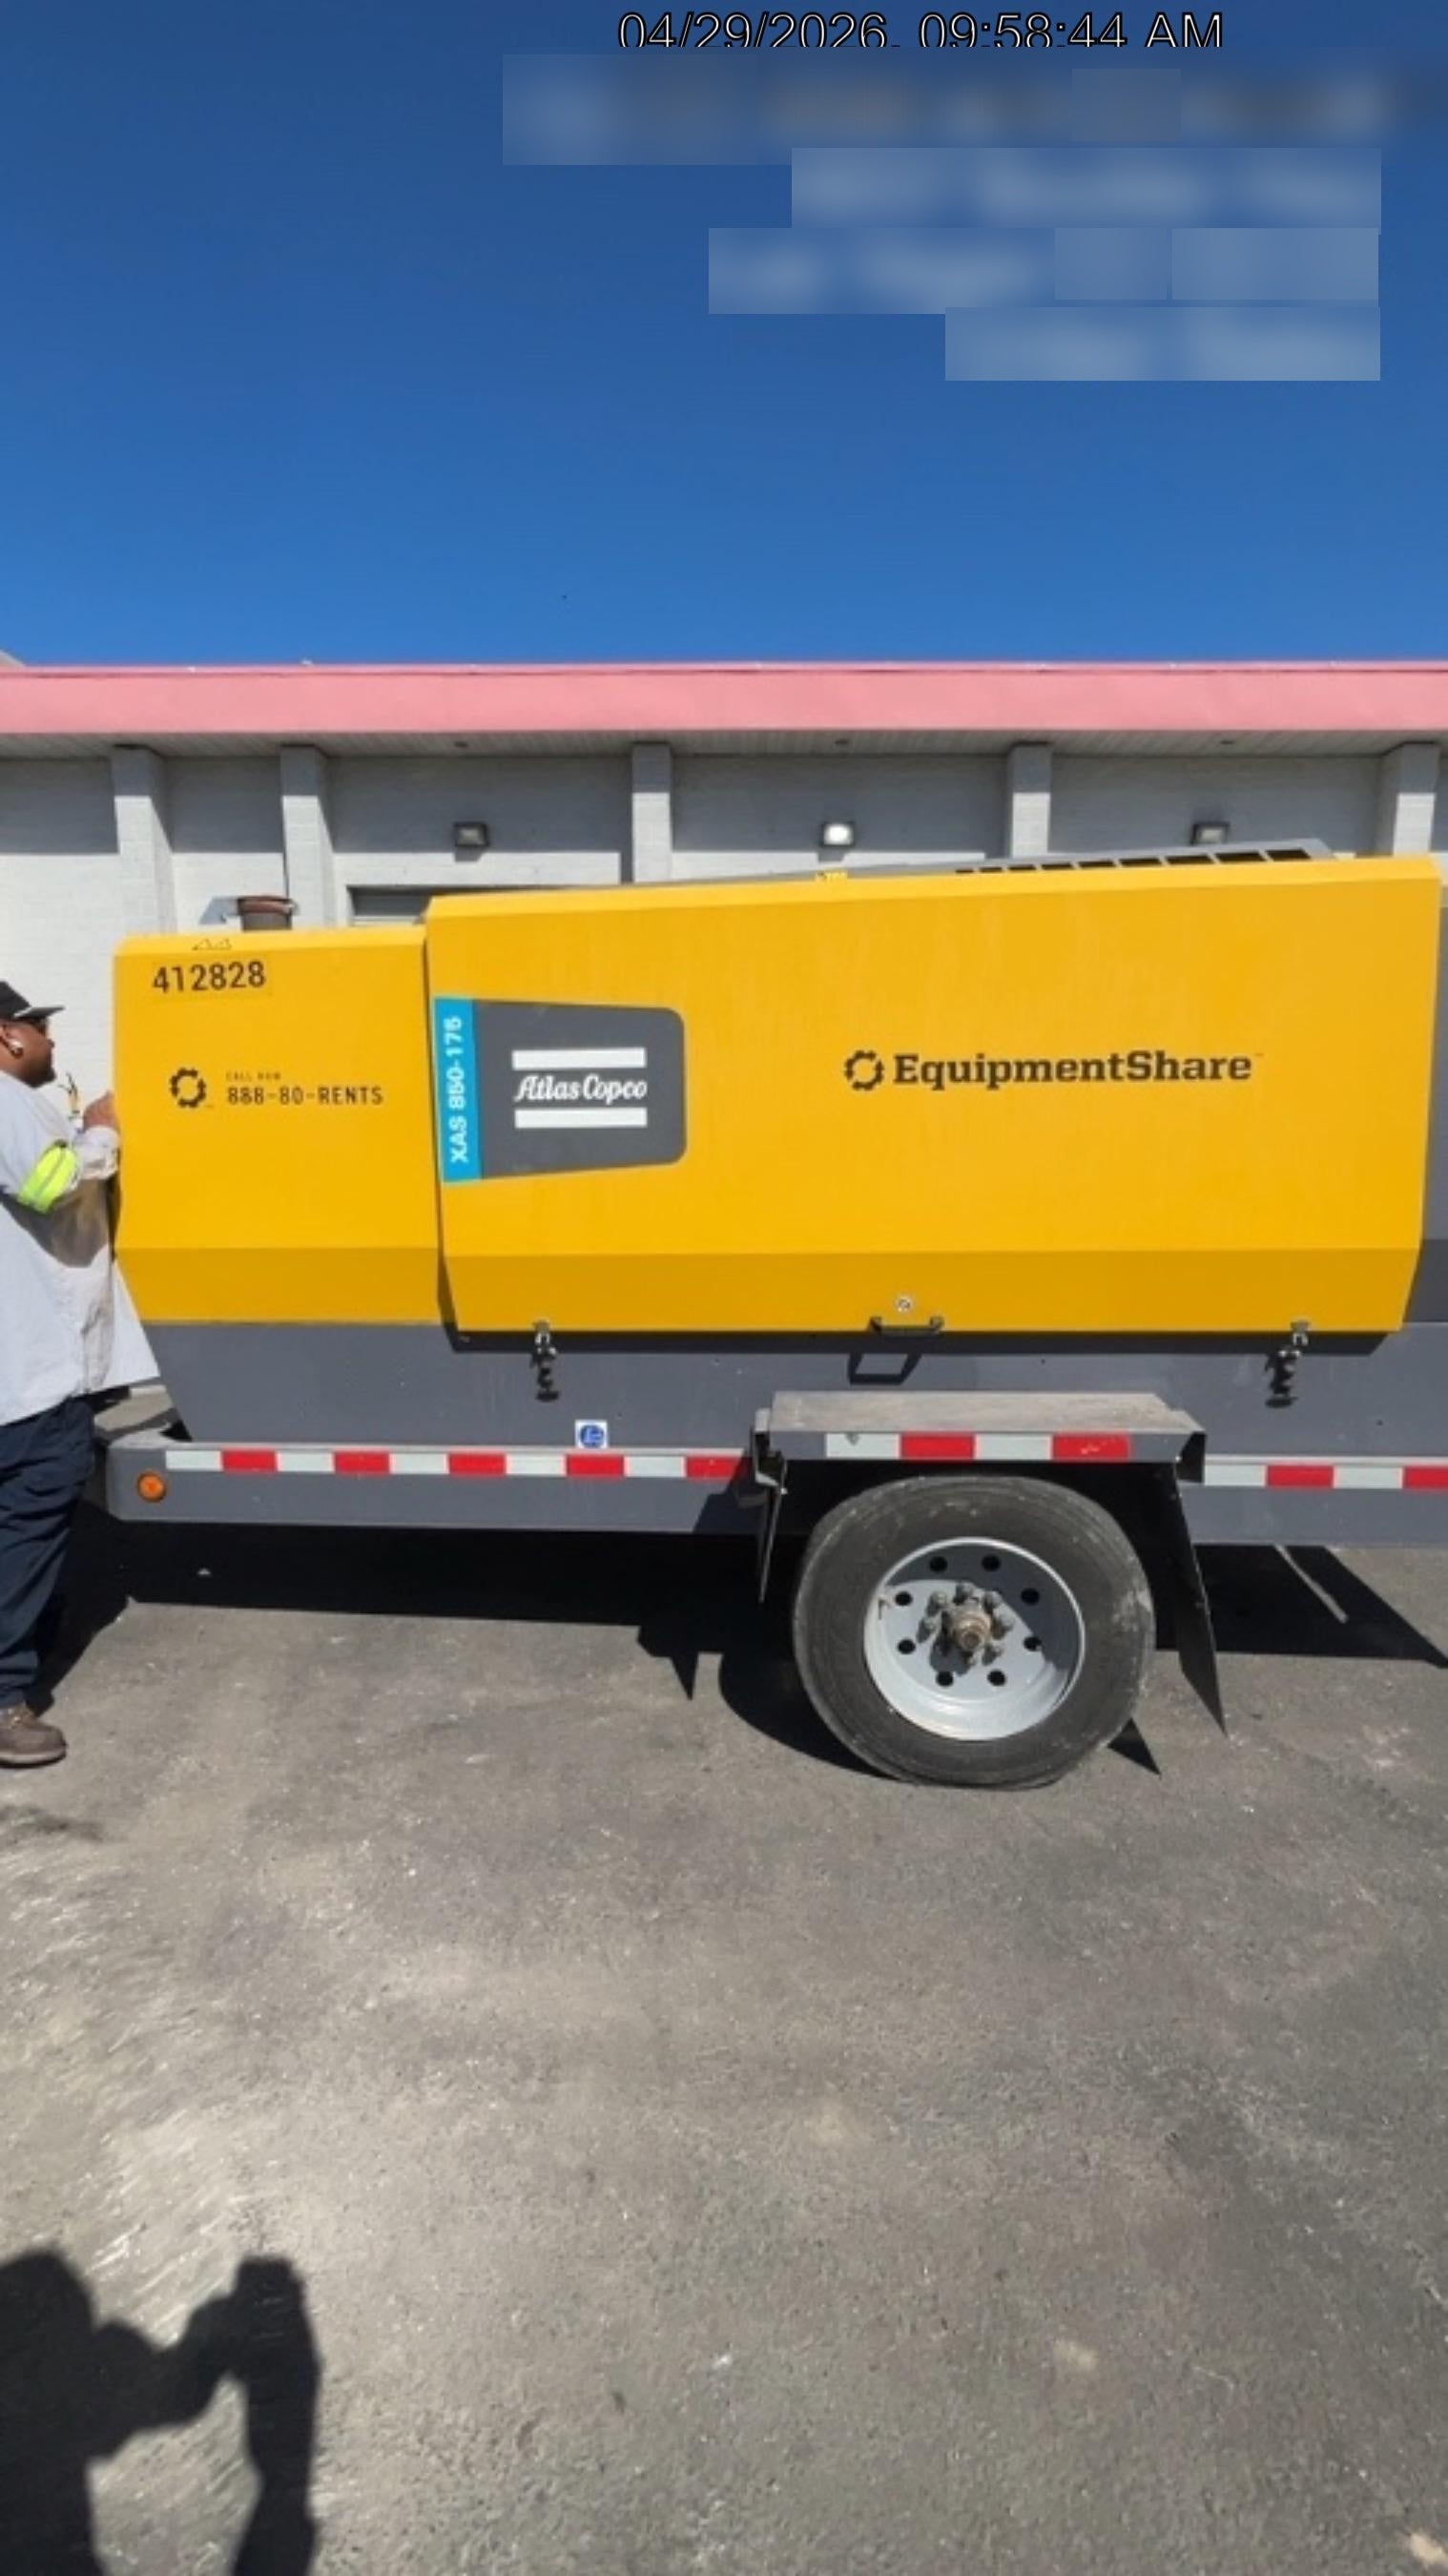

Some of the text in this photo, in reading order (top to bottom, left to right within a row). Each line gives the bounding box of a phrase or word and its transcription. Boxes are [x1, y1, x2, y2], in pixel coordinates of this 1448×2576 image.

[153, 960, 266, 993] 412828
[893, 1049, 1252, 1091] EquipmentShare
[227, 1086, 383, 1106] 888-80-RENTS
[443, 1014, 469, 1164] XAS 850-175
[513, 1073, 649, 1106] Atlas Copco
